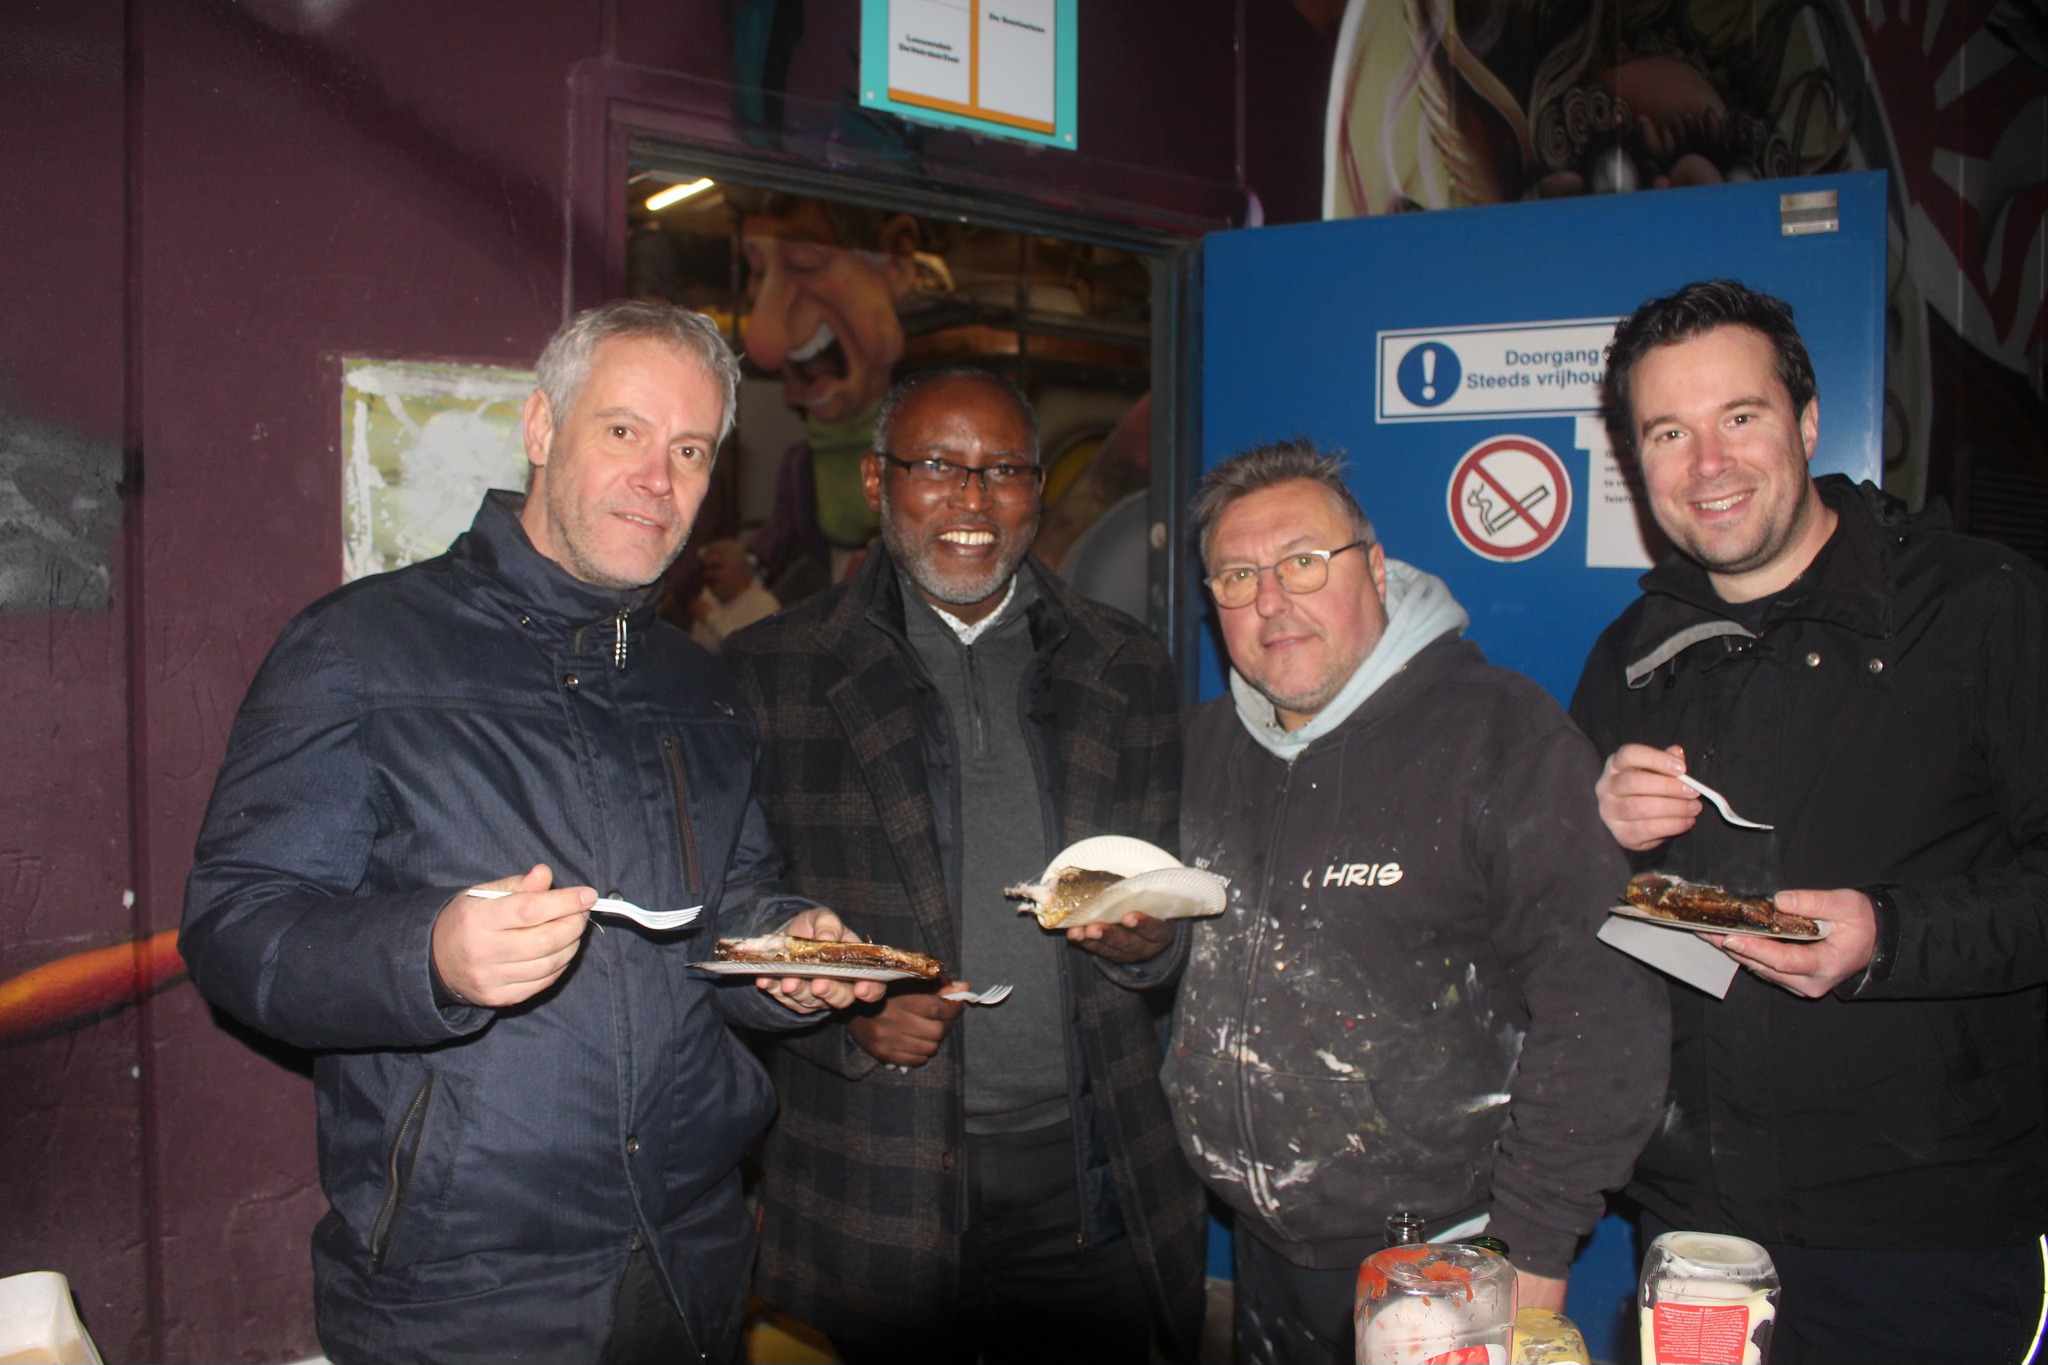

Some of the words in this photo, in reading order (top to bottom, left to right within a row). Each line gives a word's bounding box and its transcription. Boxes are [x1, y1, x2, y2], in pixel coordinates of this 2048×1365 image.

[1506, 350, 1599, 367] Doorgang
[1467, 371, 1531, 389] Steeds
[1537, 370, 1604, 389] vrijhou
